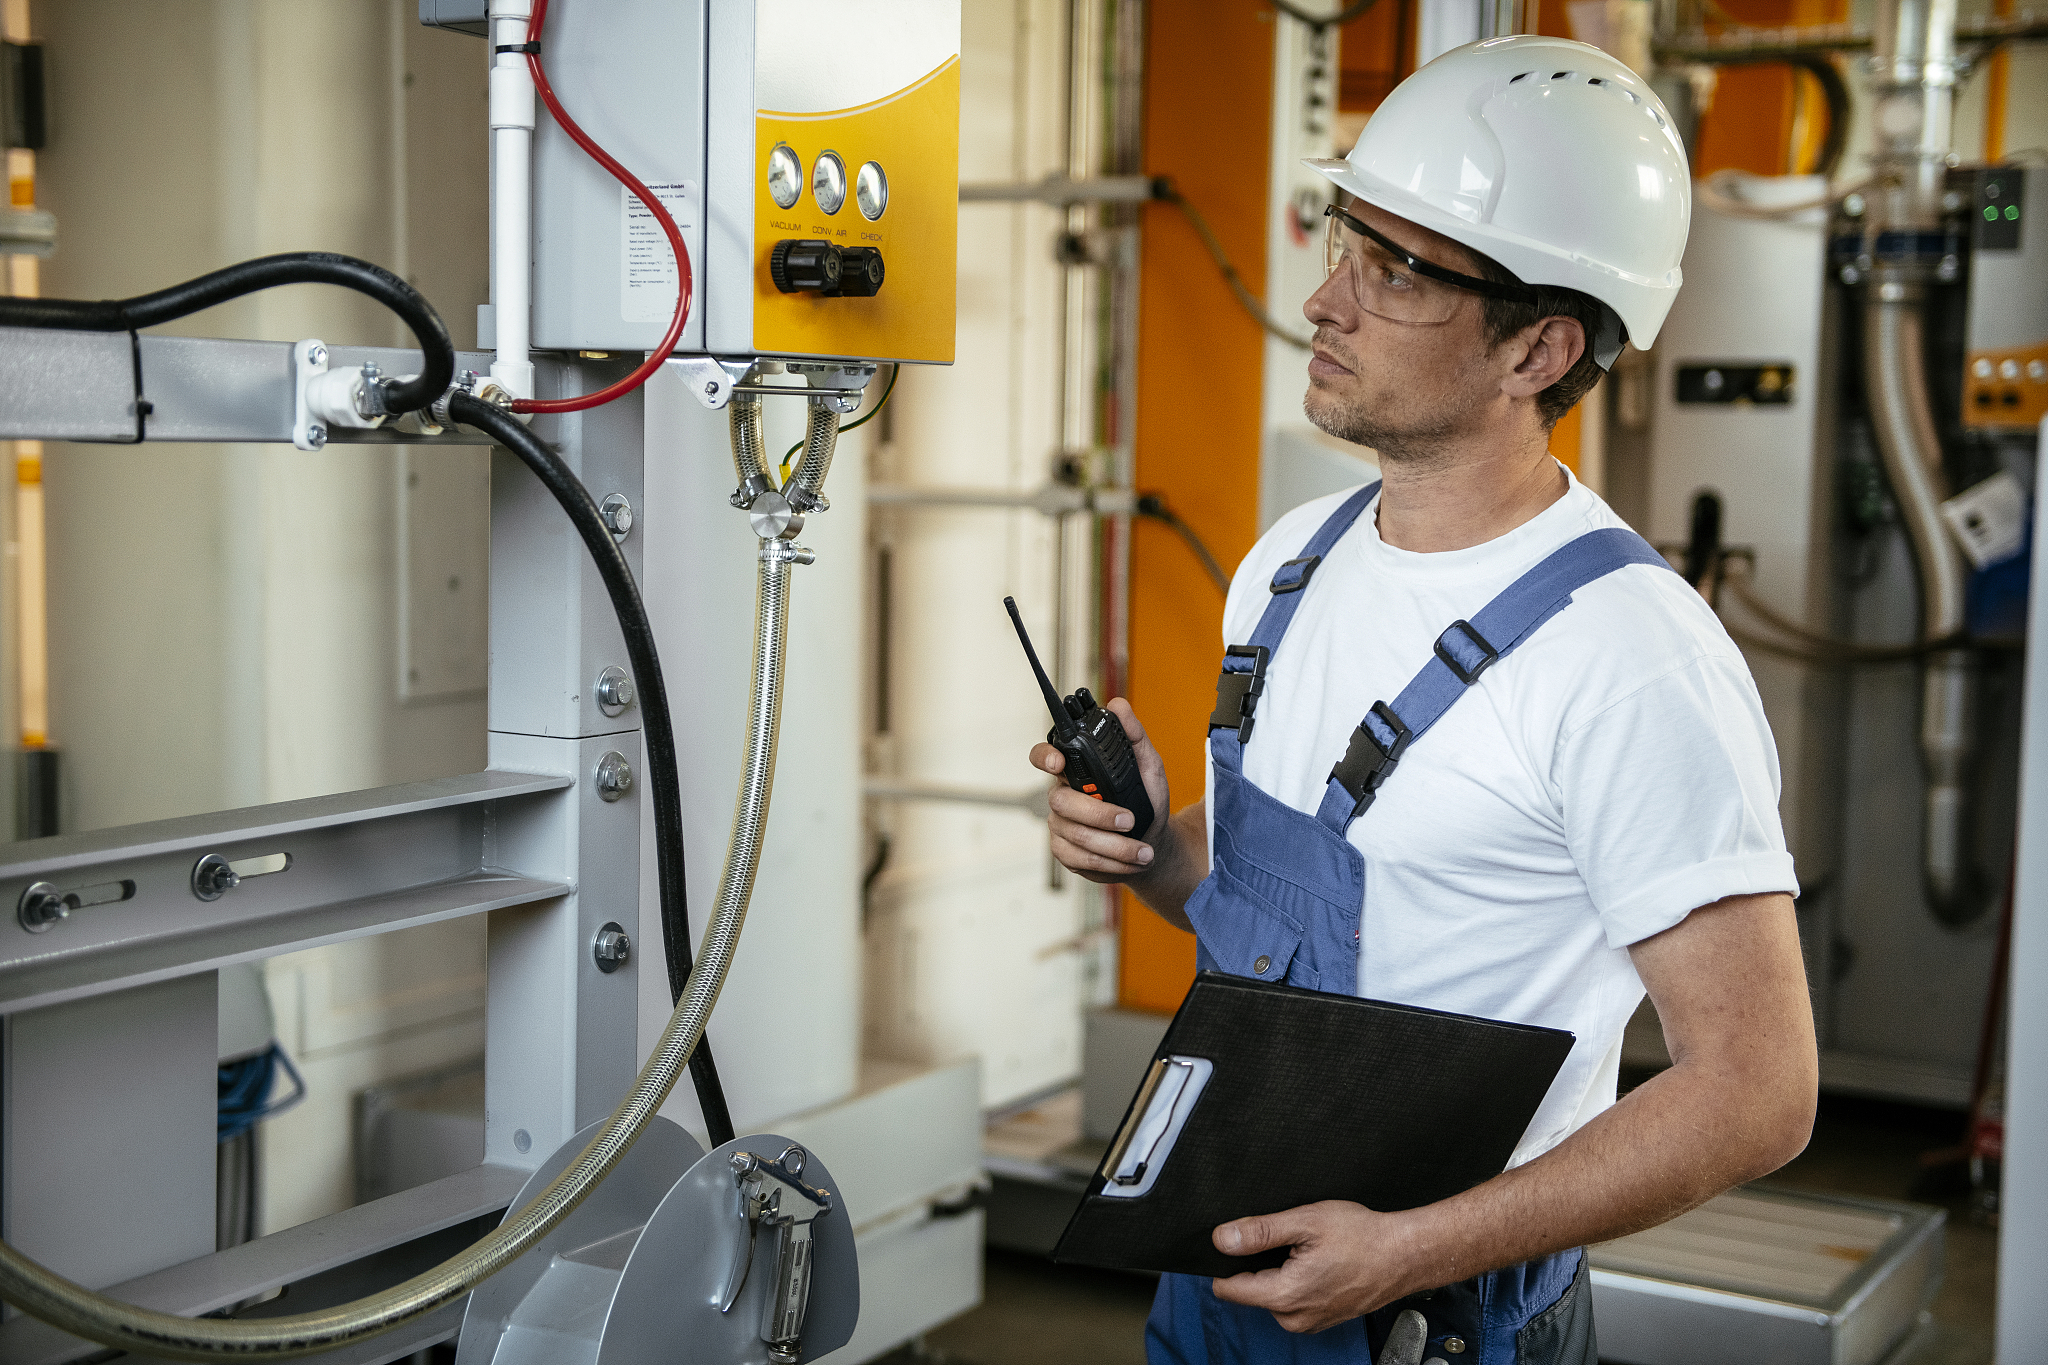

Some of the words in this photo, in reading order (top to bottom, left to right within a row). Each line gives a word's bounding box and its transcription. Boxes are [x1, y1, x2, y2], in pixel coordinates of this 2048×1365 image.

[770, 220, 802, 232] VACUUM
[836, 229, 848, 237] AIR
[860, 232, 883, 242] CHECK
